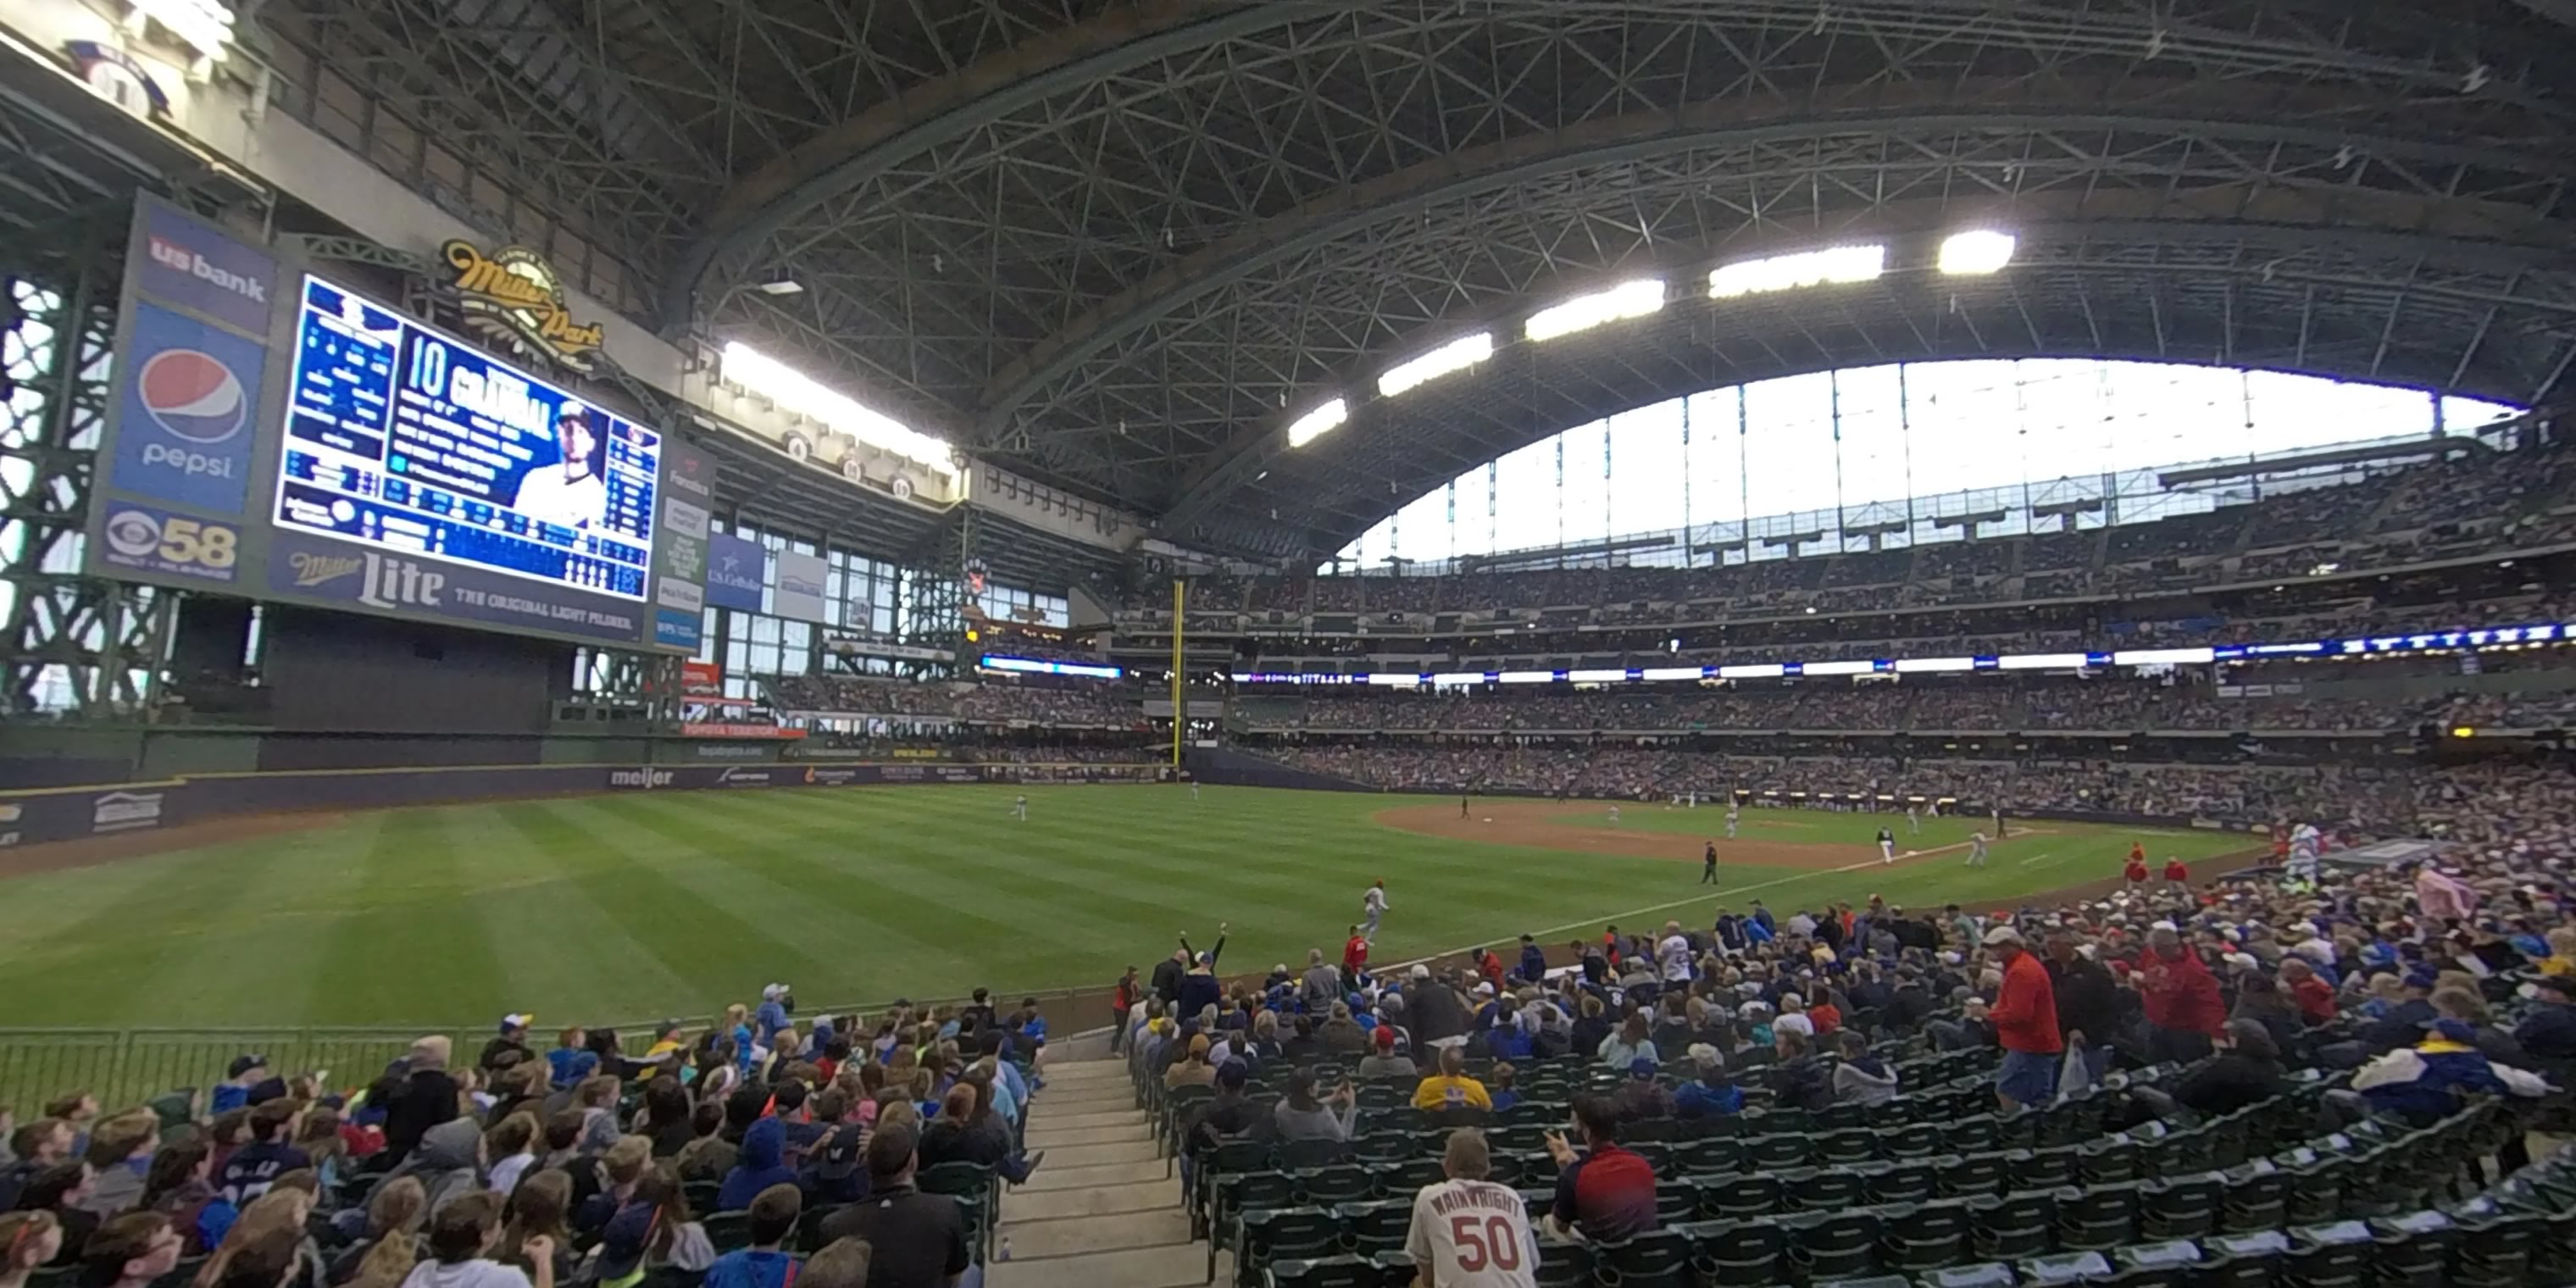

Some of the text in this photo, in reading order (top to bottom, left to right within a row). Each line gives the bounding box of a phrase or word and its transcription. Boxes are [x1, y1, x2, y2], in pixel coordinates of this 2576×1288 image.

[447, 242, 550, 303] Miller
[533, 298, 603, 347] Park
[410, 336, 447, 397] 10
[143, 444, 232, 479] pepsi
[159, 517, 236, 569] 58
[358, 551, 446, 608] Lite
[454, 587, 484, 607] THE
[488, 591, 549, 616] ORIGINAL
[552, 604, 587, 625] LIGHT
[611, 767, 675, 789] meijer
[1430, 1188, 1520, 1219] WAINWRIGHT
[1452, 1215, 1520, 1273] 50
